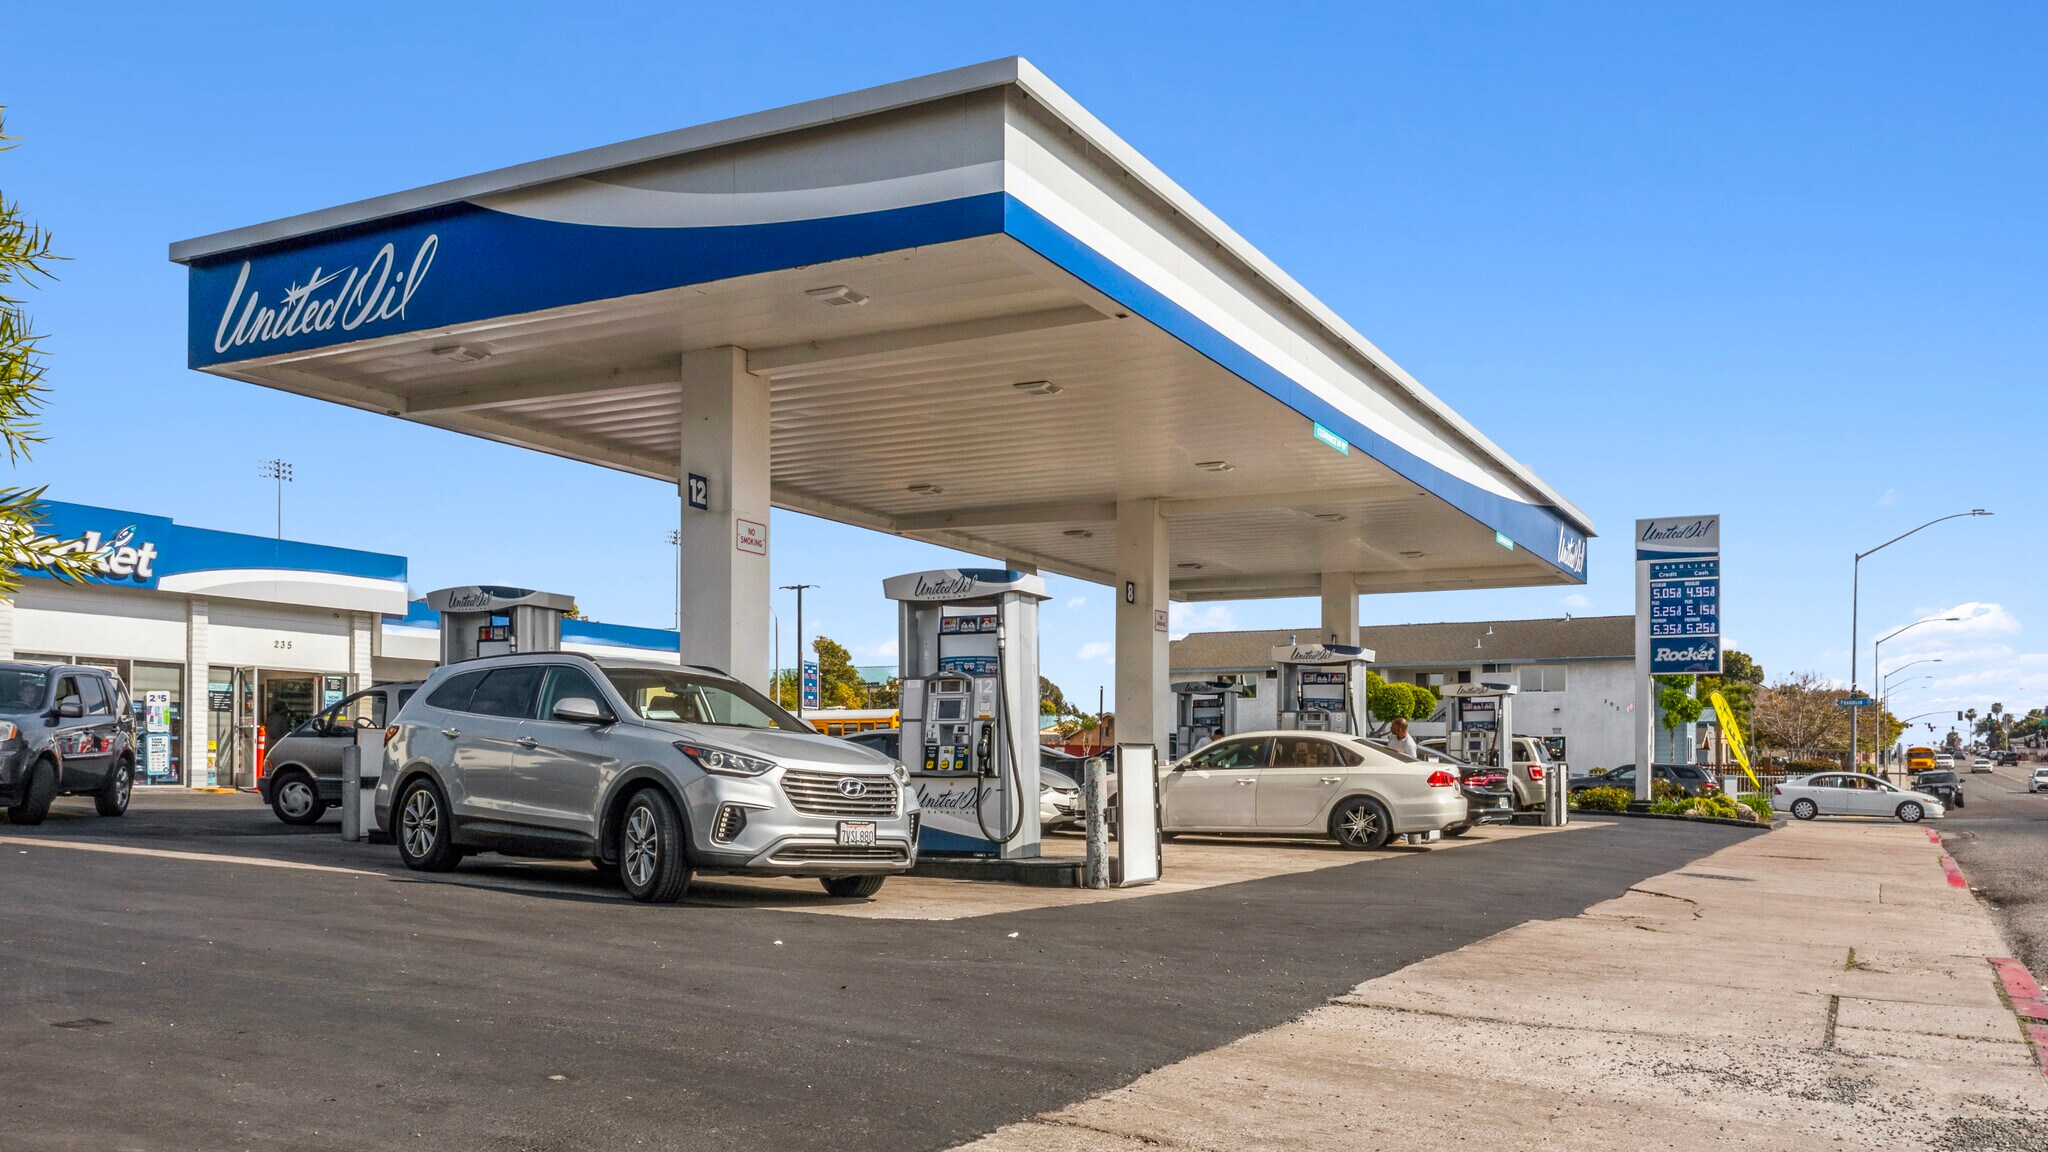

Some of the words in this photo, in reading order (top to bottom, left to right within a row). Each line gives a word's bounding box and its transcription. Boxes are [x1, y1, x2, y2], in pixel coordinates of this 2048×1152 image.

[214, 261, 358, 353] United
[341, 234, 439, 331] Oil
[689, 479, 707, 505] 12
[747, 528, 756, 536] NO
[1642, 521, 1687, 541] United
[1684, 519, 1715, 538] Oil
[740, 535, 763, 548] SMOKING
[1558, 521, 1577, 569] United
[1655, 562, 1714, 570] GASOLINE
[914, 575, 955, 597] United
[953, 574, 978, 595] Oil
[1127, 583, 1134, 602] 8
[448, 590, 477, 609] United
[475, 590, 494, 607] Oil
[274, 640, 293, 650] 235
[1290, 647, 1320, 661] United
[1654, 646, 1716, 662] Rocket
[976, 680, 993, 693] 12
[149, 694, 156, 702] 2
[917, 783, 964, 808] United
